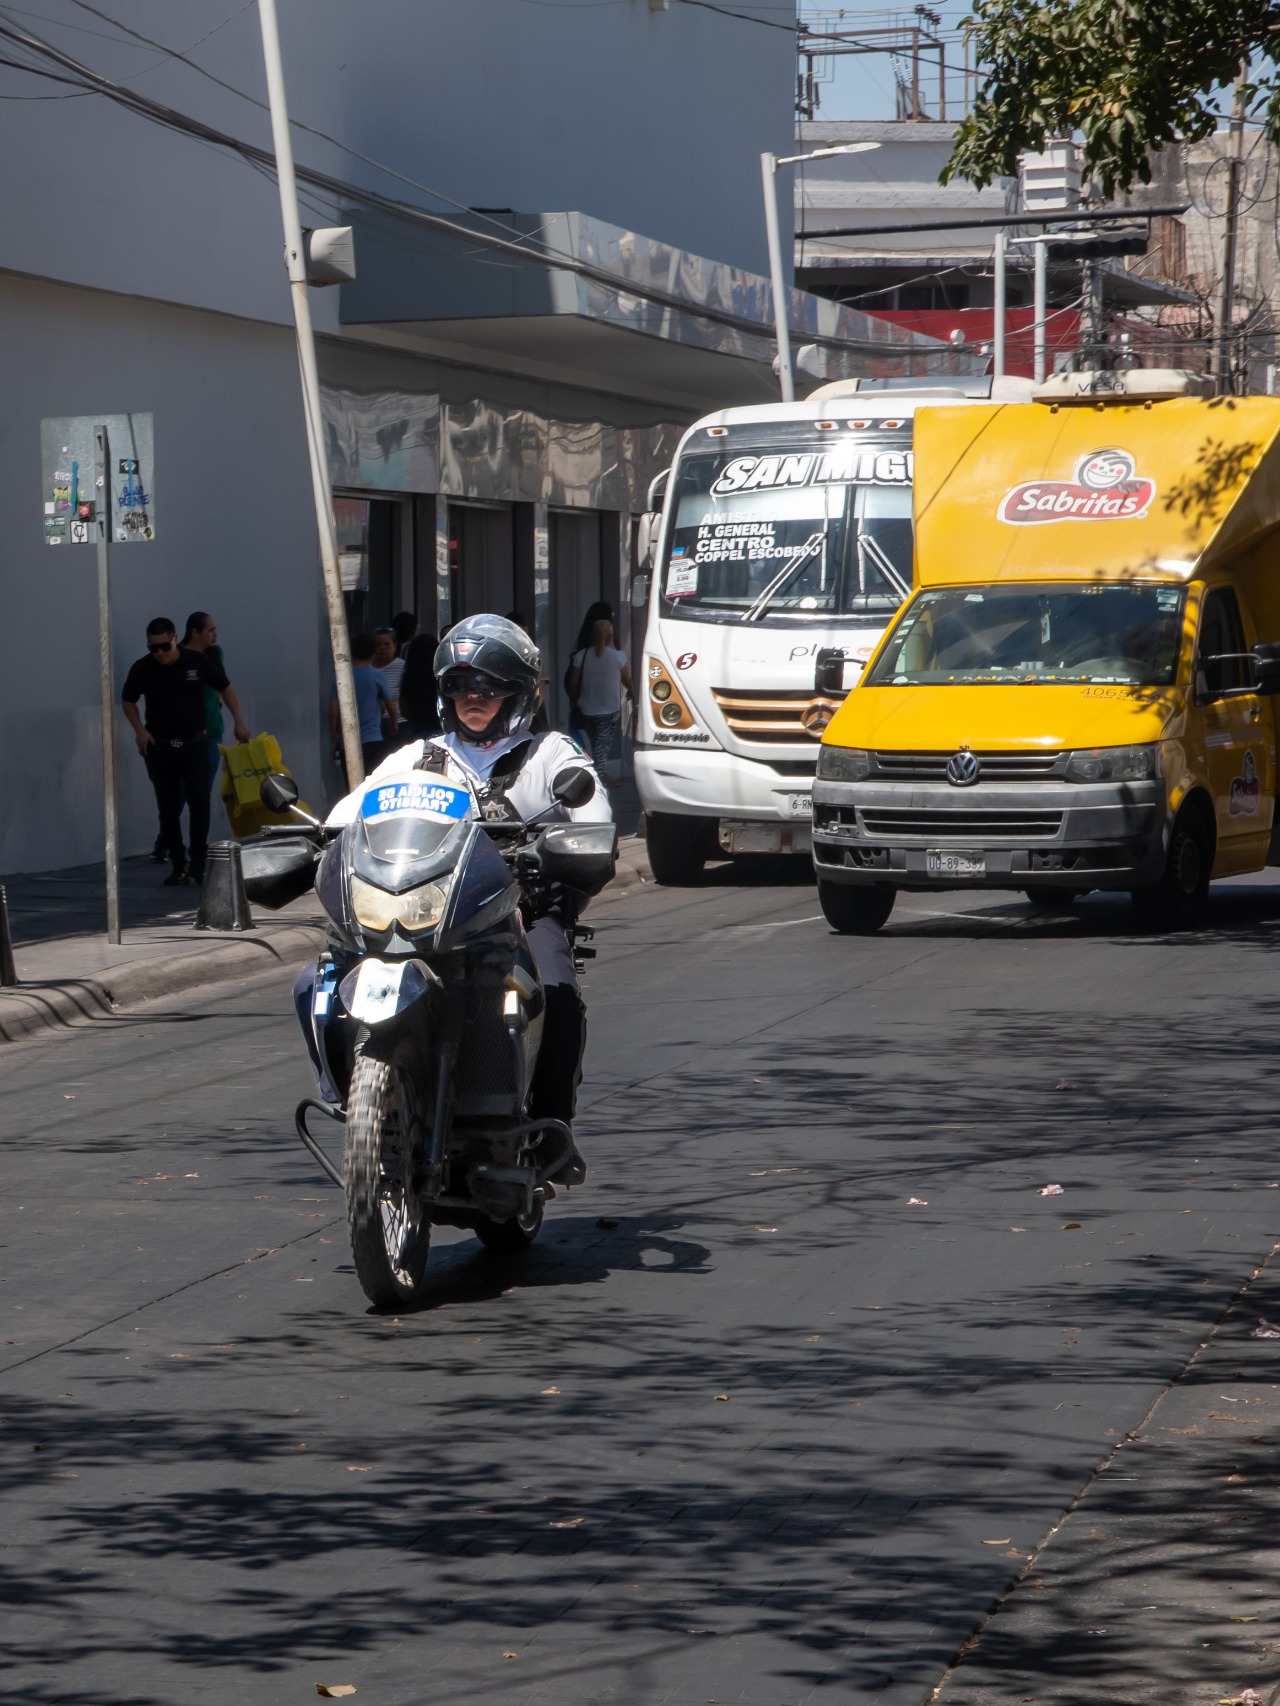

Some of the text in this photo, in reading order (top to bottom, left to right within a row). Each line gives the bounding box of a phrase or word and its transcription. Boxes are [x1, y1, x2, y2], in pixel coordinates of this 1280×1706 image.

[1078, 381, 1124, 393] VIESA
[713, 454, 813, 493] SAN
[1016, 488, 1139, 515] Sabritas
[697, 523, 776, 539] H. GENERAL
[696, 536, 776, 552] CENTRO
[694, 549, 746, 563] COPPEL
